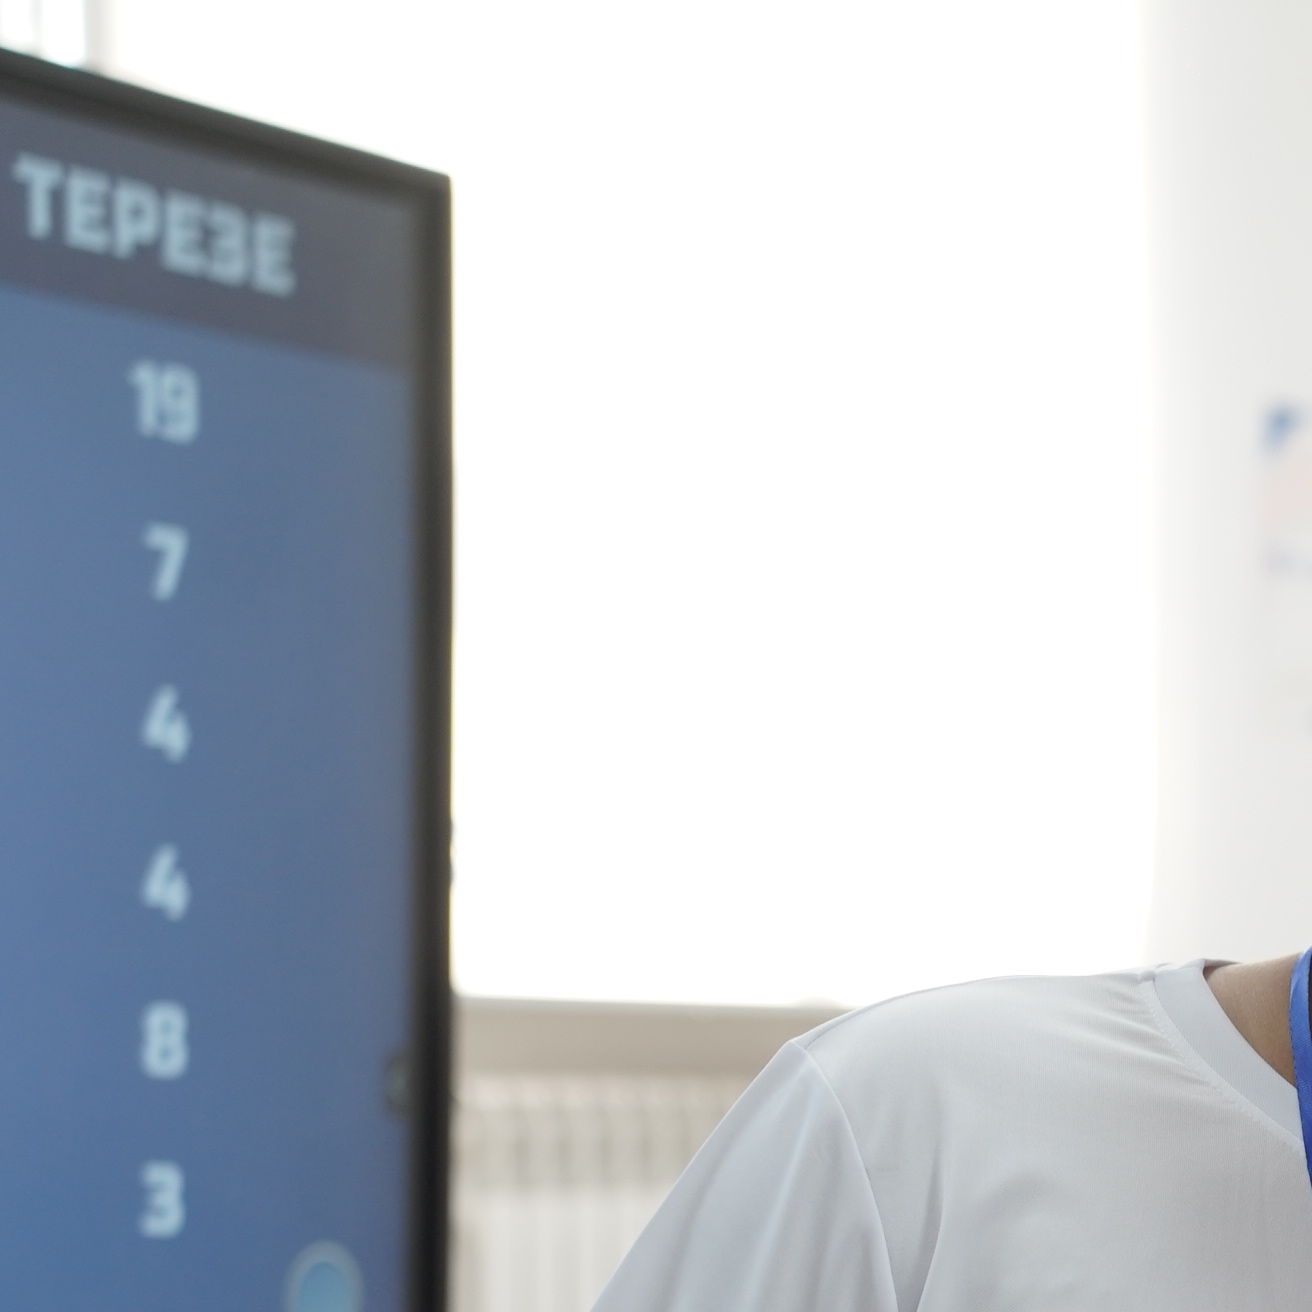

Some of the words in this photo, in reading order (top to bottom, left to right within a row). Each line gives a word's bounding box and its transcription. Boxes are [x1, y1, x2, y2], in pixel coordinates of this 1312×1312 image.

[13, 154, 296, 297] ТЕРЕЗЕ
[129, 360, 201, 445] 19
[145, 524, 189, 602] 7
[143, 686, 191, 761] 4
[142, 846, 191, 920] 4
[142, 1002, 189, 1080] 8
[141, 1161, 186, 1239] 3
